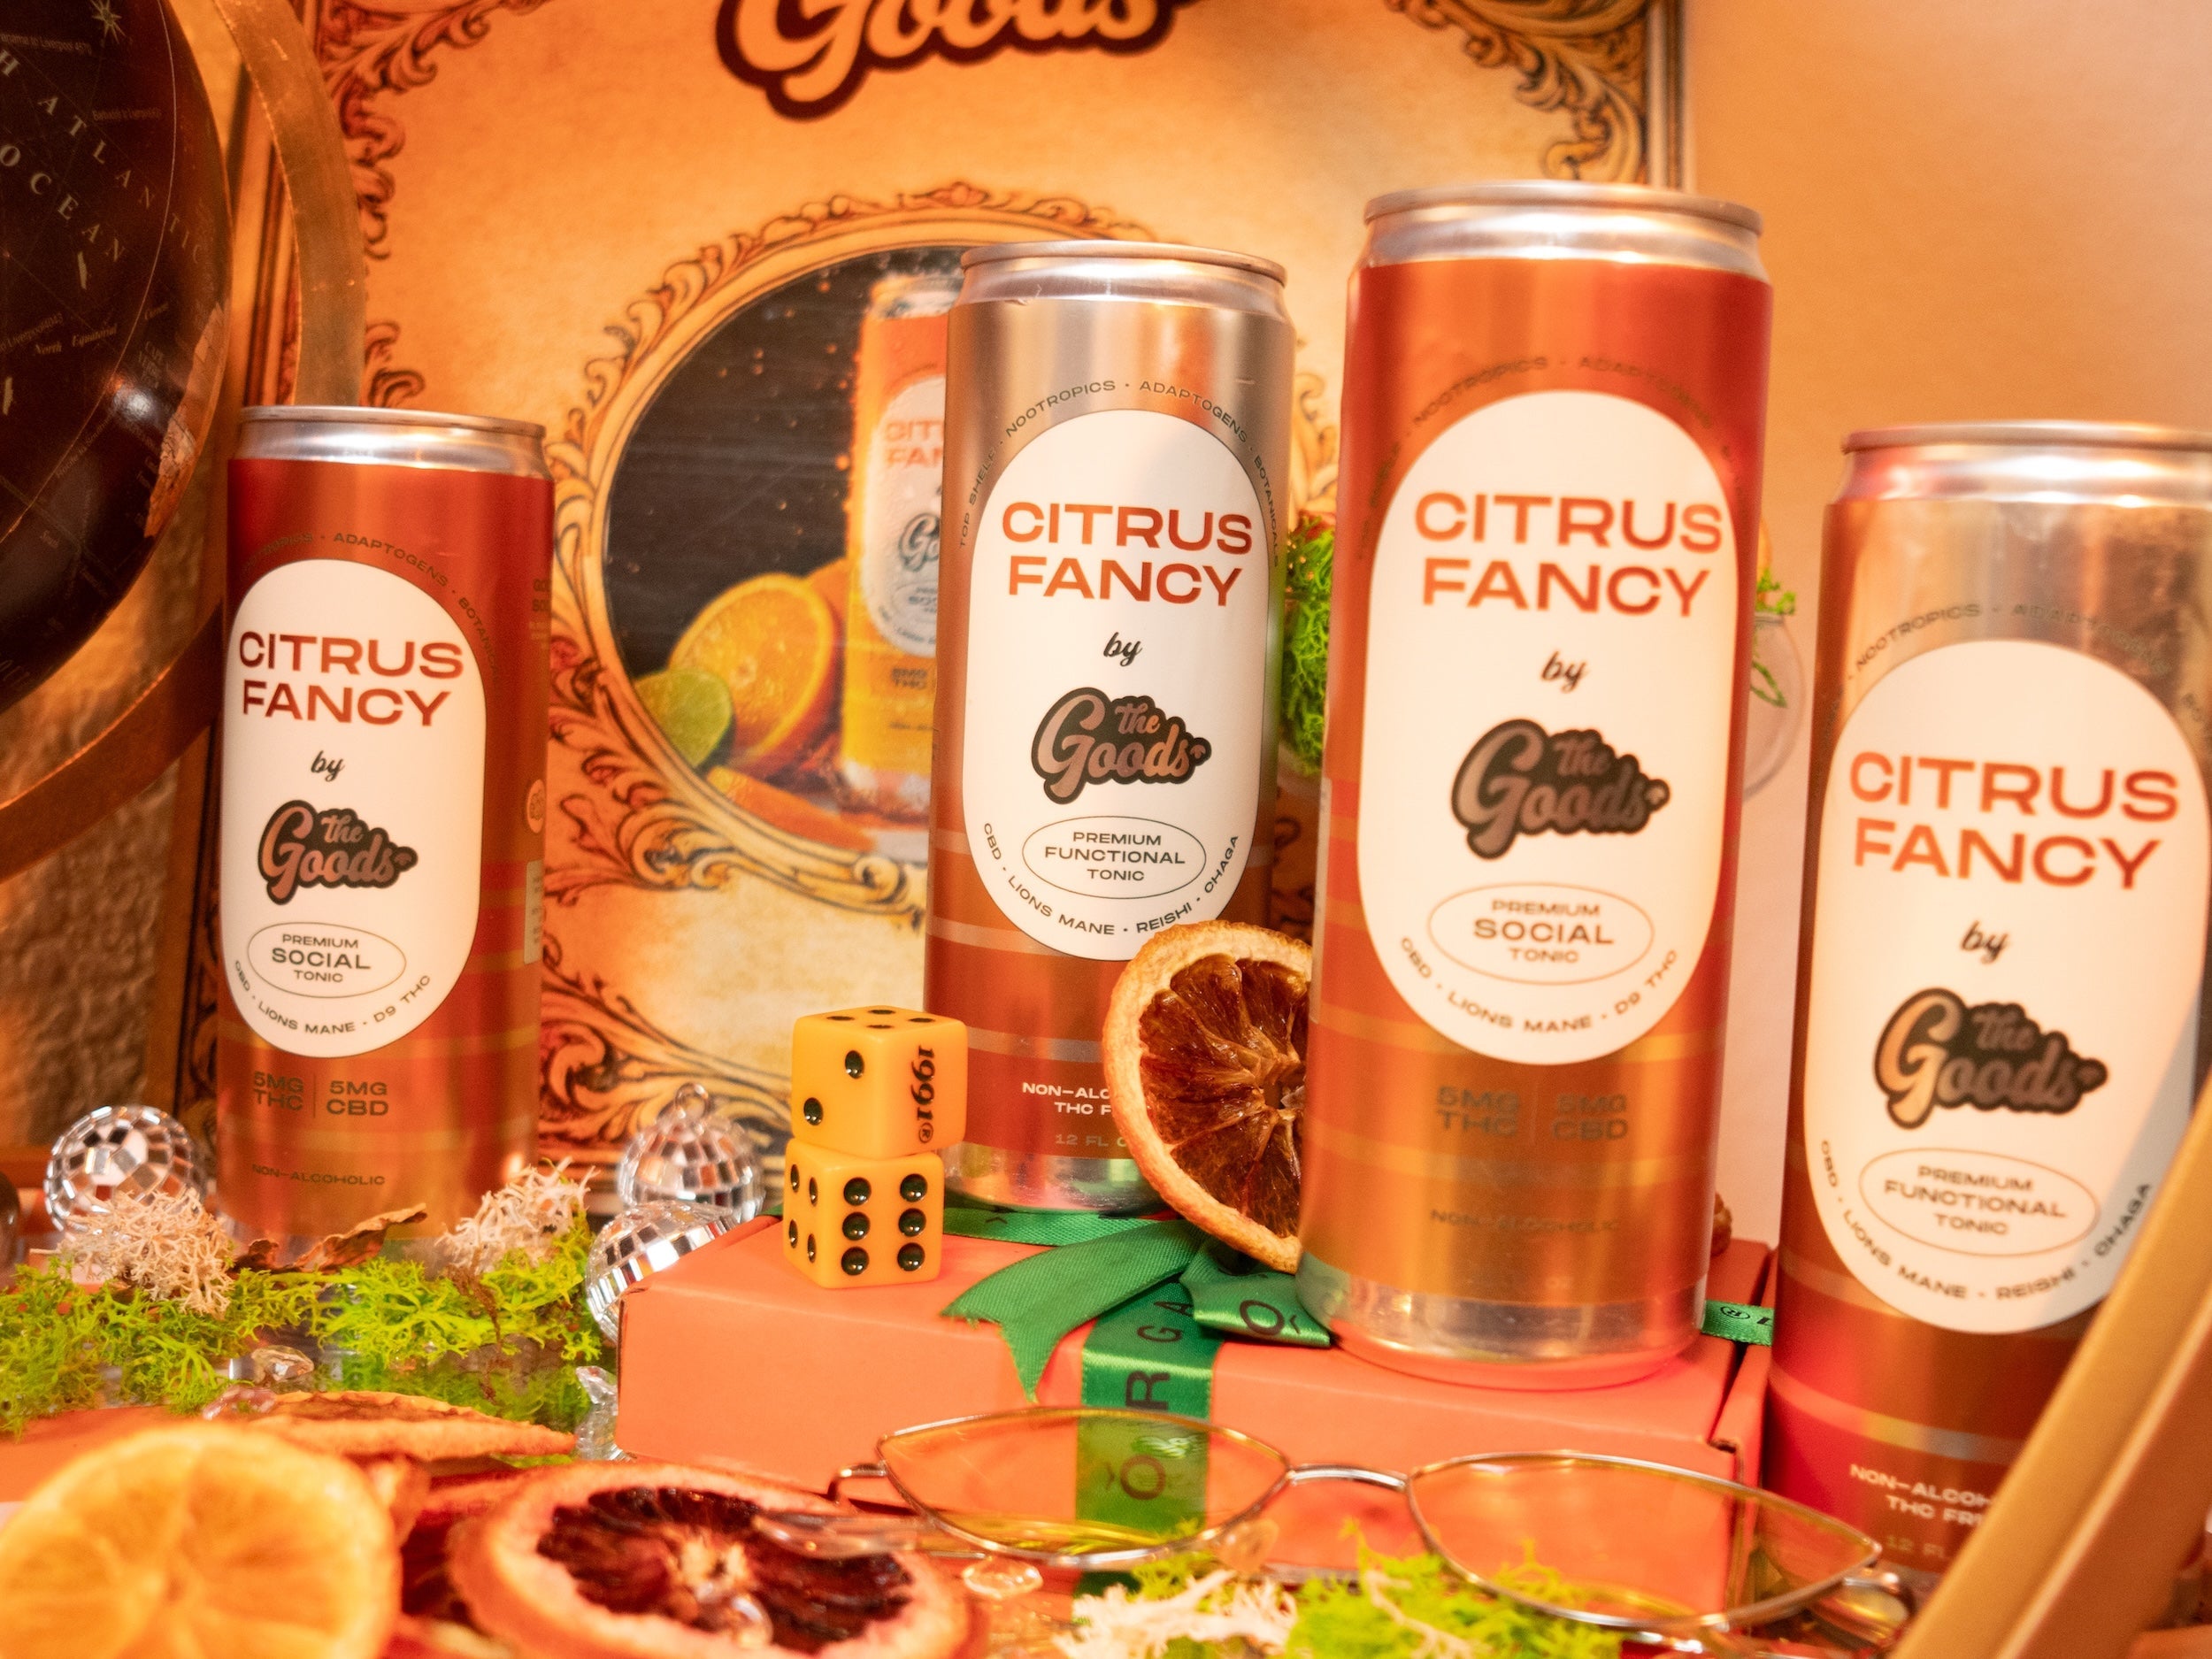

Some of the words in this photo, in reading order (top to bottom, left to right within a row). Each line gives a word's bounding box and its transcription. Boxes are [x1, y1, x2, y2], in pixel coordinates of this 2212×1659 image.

[960, 512, 972, 548] TOP
[969, 449, 996, 506] SHELF
[1005, 380, 1117, 437] NOOTROPICS
[1139, 380, 1248, 443] ADAPTOGENS
[1254, 455, 1279, 567] BOTANICALS
[1002, 502, 1252, 555] CITRUS
[1416, 492, 1723, 555] CITRUS
[333, 532, 449, 588] ADAPTOGENS
[1009, 555, 1243, 607] FANCY
[1423, 557, 1710, 618] FANCY
[239, 631, 465, 680] CITRUS
[1102, 632, 1142, 667] by
[1855, 603, 1981, 672] NOOTROPICS
[1540, 650, 1586, 692] by
[243, 680, 451, 726] FANCY
[1113, 702, 1161, 734] the
[1036, 693, 1193, 799] Goods
[1553, 737, 1611, 776] the
[311, 750, 344, 782] by
[1455, 726, 1648, 857] Goods
[1849, 751, 2179, 823] CITRUS
[320, 814, 364, 843] the
[1072, 832, 1162, 847] PREMIUM
[260, 805, 396, 901] Goods
[1044, 846, 1186, 864] FUNCTIONAL
[1855, 818, 2162, 890] FANCY
[984, 823, 1002, 861] CBD
[1008, 875, 1053, 918] LIONS
[1058, 913, 1115, 936] MANE
[1136, 902, 1193, 934] REISHI
[1204, 834, 1240, 895] CHAGA
[1087, 868, 1145, 882] TONIC
[1491, 899, 1601, 917] PREMIUM
[282, 933, 358, 949] PREMIUM
[1473, 918, 1614, 945] SOCIAL
[1960, 919, 2008, 964] by
[271, 948, 371, 970] SOCIAL
[1508, 948, 1579, 964] TONIC
[293, 970, 343, 983] TONIC
[234, 960, 250, 991] CBD
[257, 1000, 298, 1030] LIONS
[304, 1022, 356, 1034] MANE
[373, 1005, 397, 1023] D9
[400, 975, 431, 1005] THC
[1448, 990, 1513, 1029] LIONS
[1523, 1014, 1592, 1033] MANE
[1970, 1008, 2036, 1050] the
[1876, 995, 2081, 1123] Goods
[253, 1071, 304, 1094] 5MG
[254, 1089, 303, 1111] THC
[329, 1080, 388, 1095] 5MG
[1022, 1081, 1110, 1100] NON-ALC
[326, 1099, 389, 1117] CBD
[1054, 1101, 1094, 1115] THC
[1101, 1104, 1112, 1116] F
[252, 1164, 386, 1186] NON-ALCOHOLIC
[1916, 1164, 2033, 1191] PREMIUM
[1884, 1179, 2069, 1218] FUNCTIONAL
[1843, 1209, 1893, 1268] LIONS
[1897, 1264, 1968, 1300] MANE
[1995, 1270, 2076, 1300] REISHI
[2093, 1182, 2152, 1257] CHAGA
[1933, 1213, 2008, 1235] TONIC
[1886, 1494, 1935, 1519] THC
